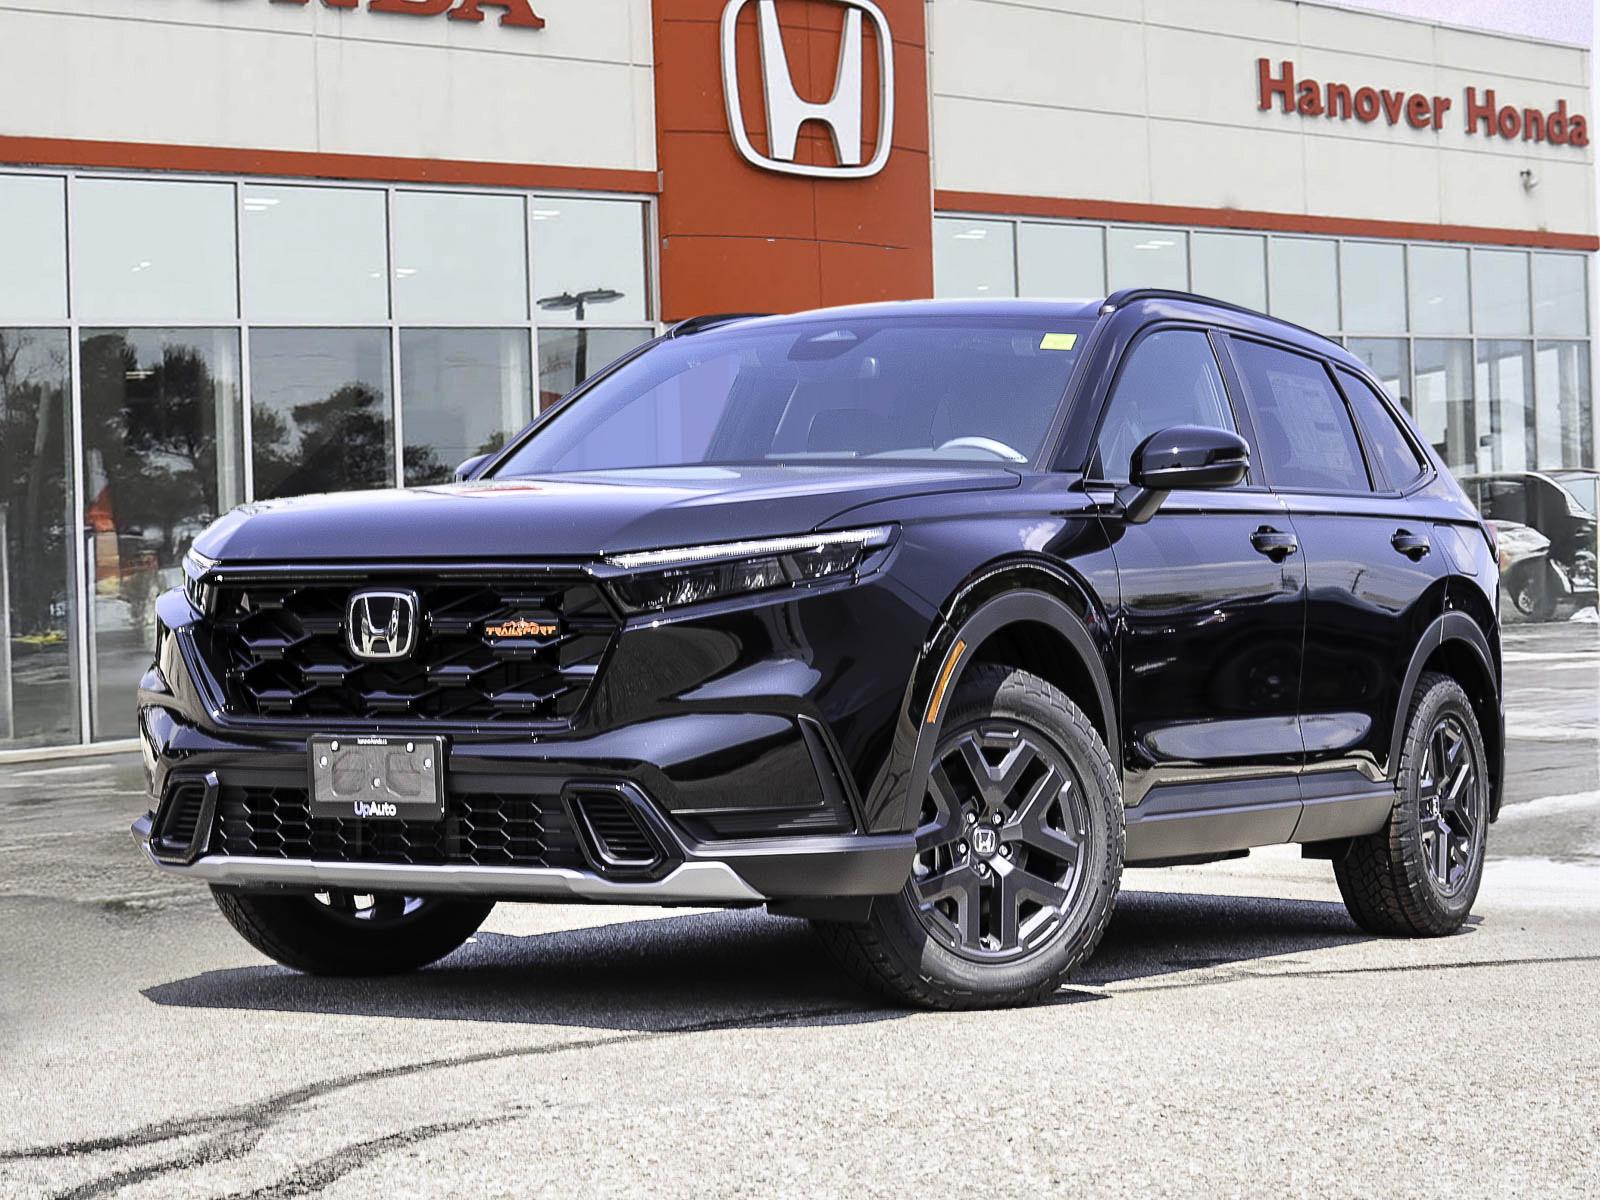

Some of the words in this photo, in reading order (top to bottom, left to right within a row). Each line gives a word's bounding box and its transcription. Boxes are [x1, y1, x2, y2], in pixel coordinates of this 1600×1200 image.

[1256, 58, 1452, 131] Hanover
[1463, 86, 1590, 148] Honda
[353, 801, 397, 818] UpAuto
